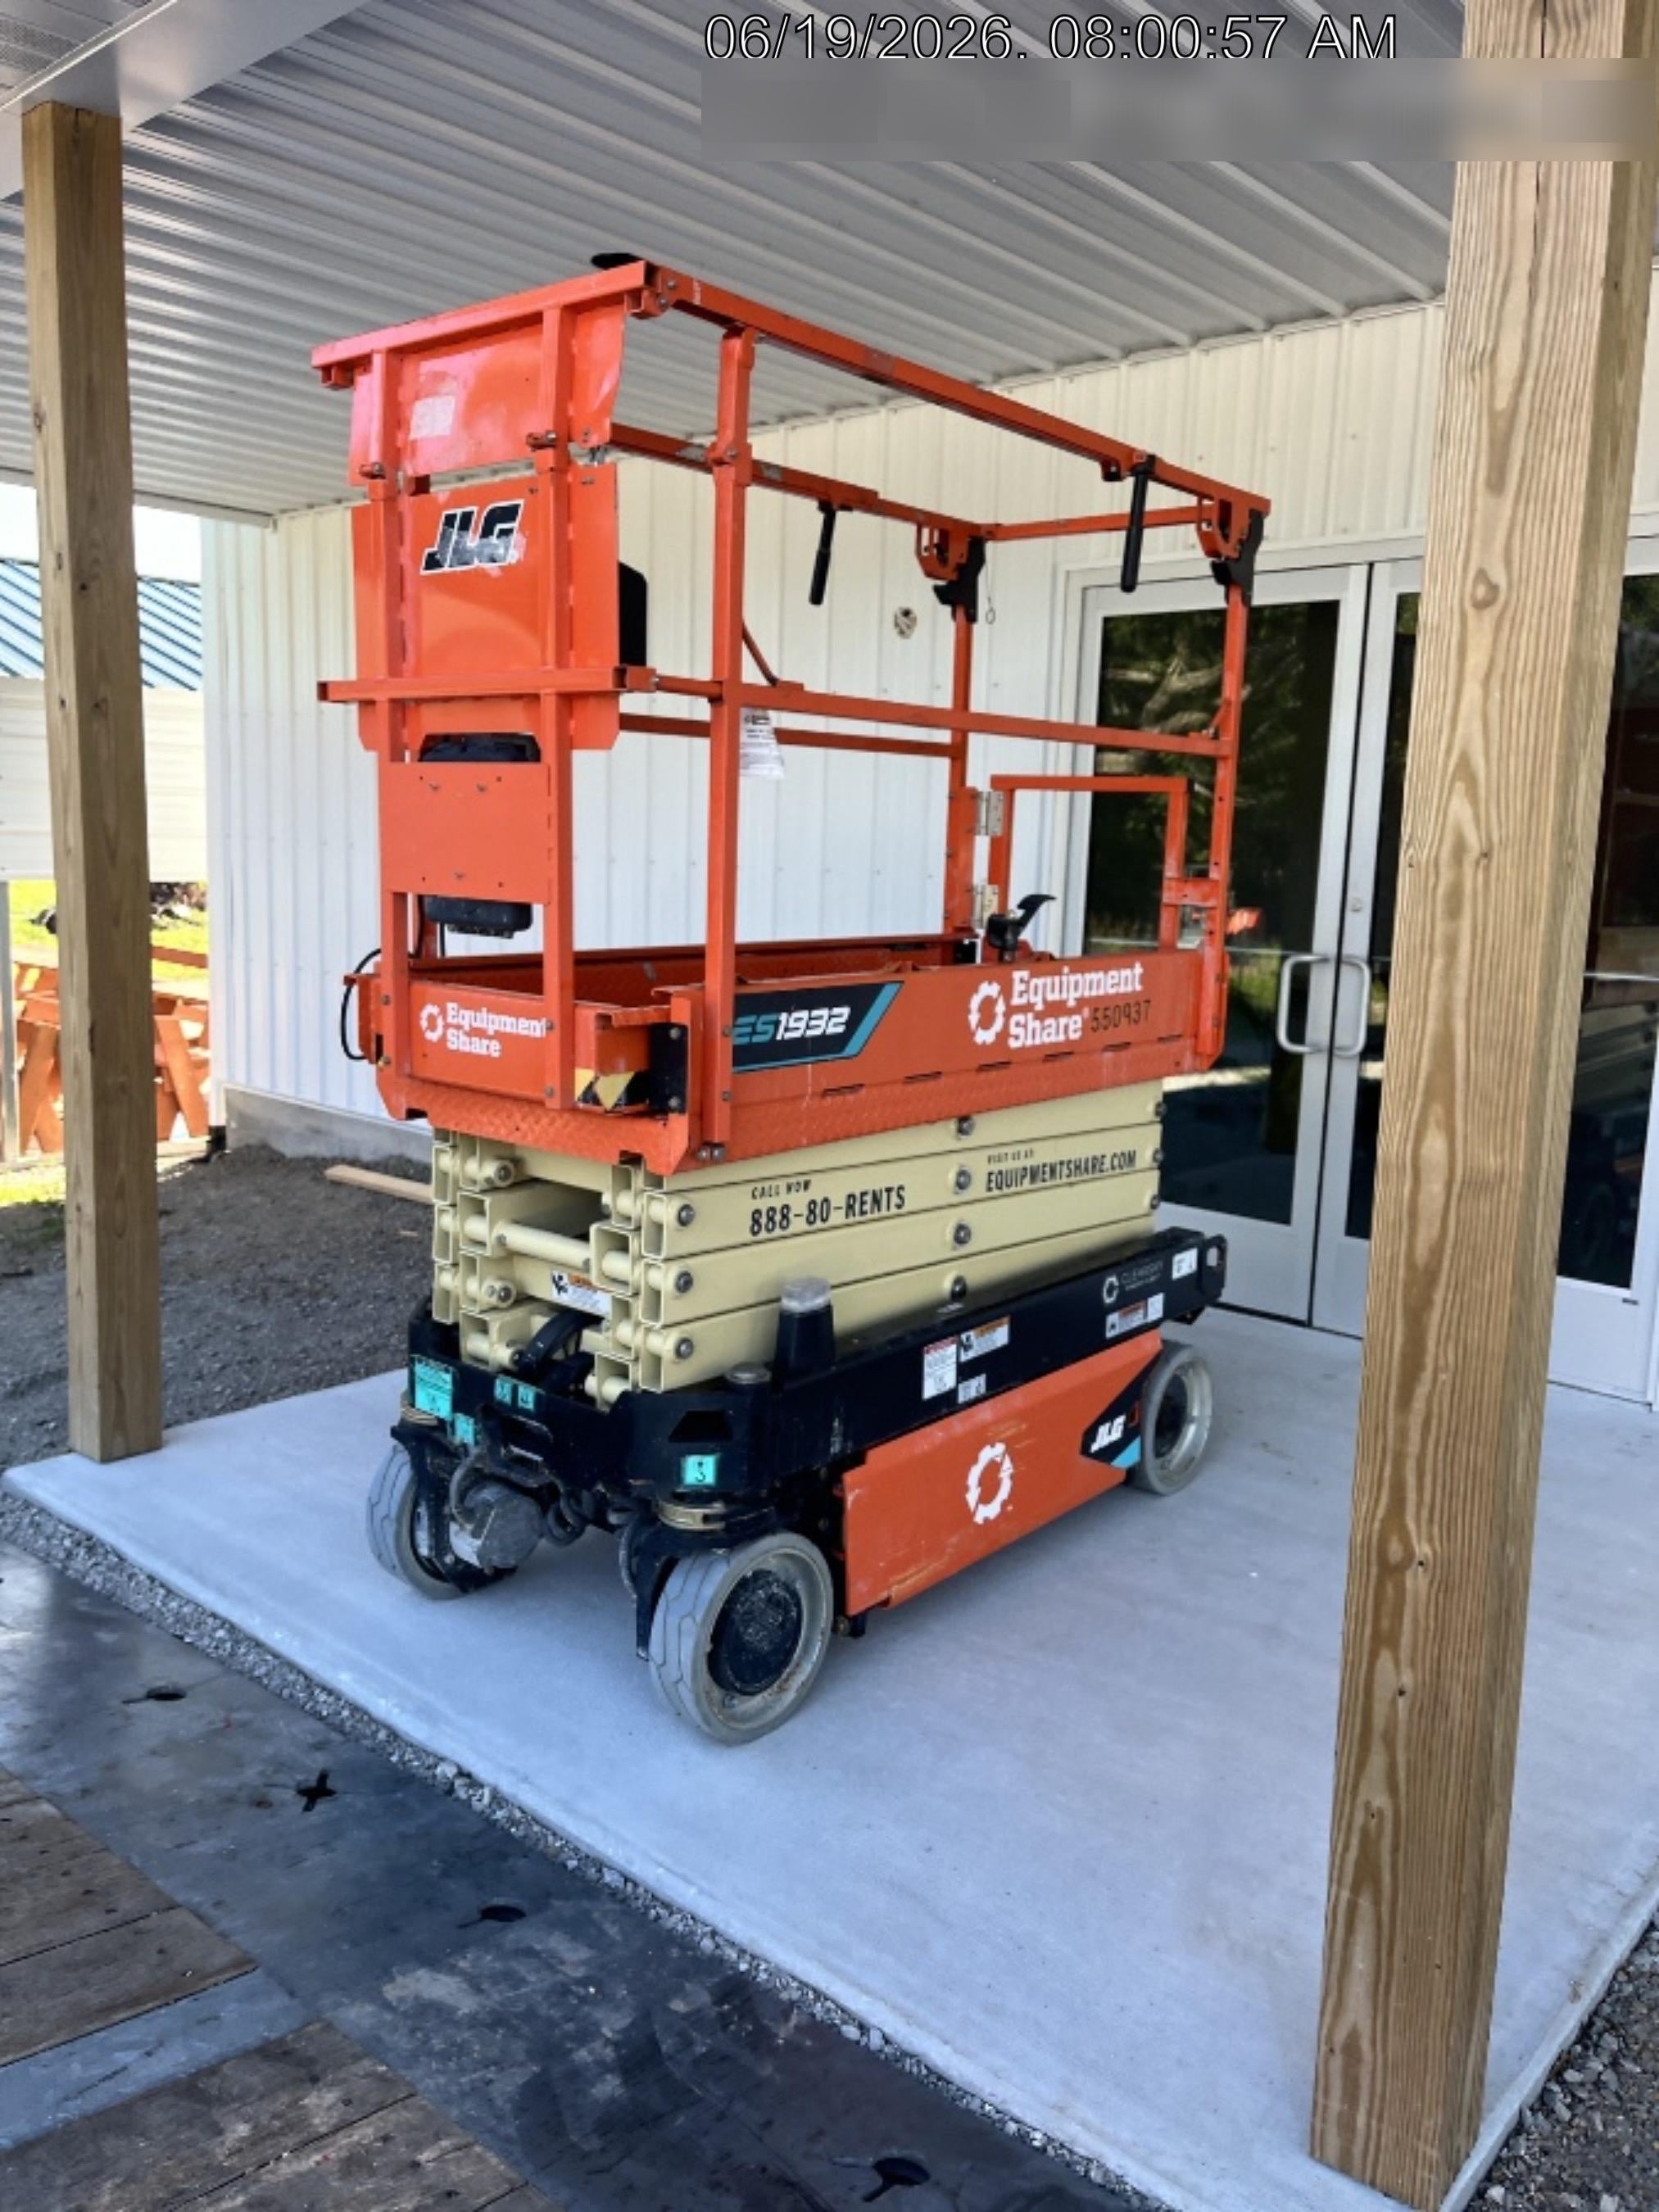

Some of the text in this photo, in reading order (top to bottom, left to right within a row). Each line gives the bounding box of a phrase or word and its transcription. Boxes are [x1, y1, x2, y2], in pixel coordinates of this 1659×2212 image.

[419, 499, 524, 575] JLG
[1010, 960, 1145, 1011] Equipment
[446, 1001, 546, 1038] Equipment
[1090, 999, 1151, 1033] 550937
[446, 1027, 501, 1058] Share
[750, 1179, 812, 1200] CALL NOW
[985, 1149, 1137, 1194] EQUIPMENTSHARE.COM
[749, 1184, 906, 1237] 888-80-RENTS
[1090, 1413, 1126, 1453] JLG
